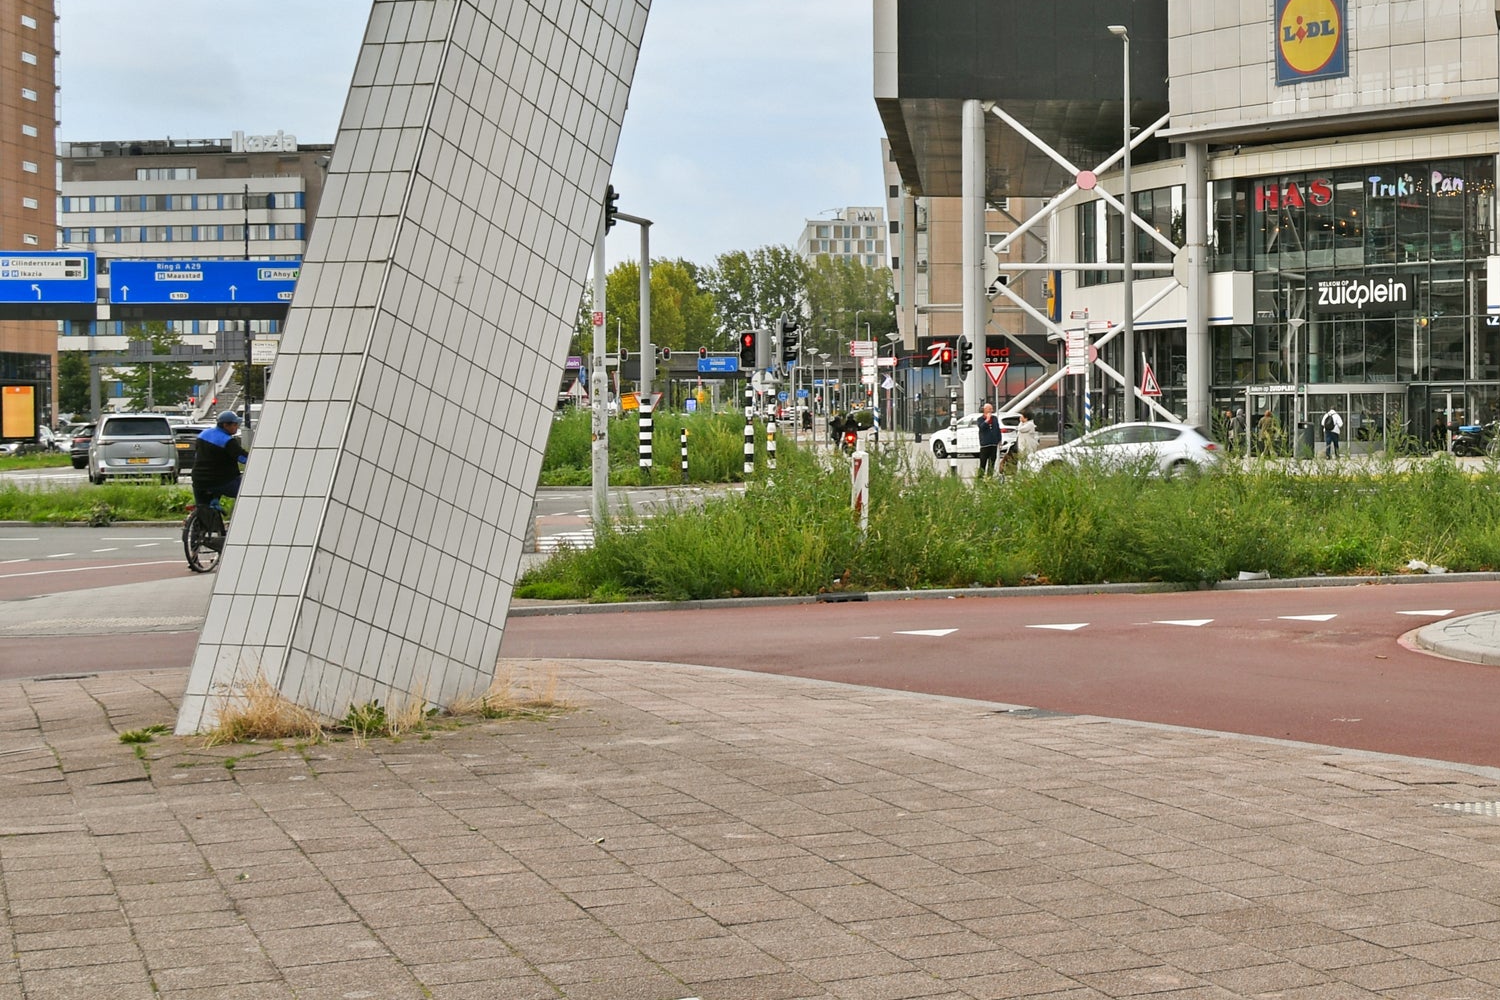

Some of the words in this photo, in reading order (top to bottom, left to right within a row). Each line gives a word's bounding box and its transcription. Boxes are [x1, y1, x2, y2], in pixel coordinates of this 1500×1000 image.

[231, 129, 298, 153] Ikazia
[1431, 170, 1464, 193] Pan
[1254, 178, 1333, 212] HAS
[156, 263, 174, 271] Ring
[273, 271, 290, 279] Ahoy
[1318, 277, 1407, 309] zuidplein
